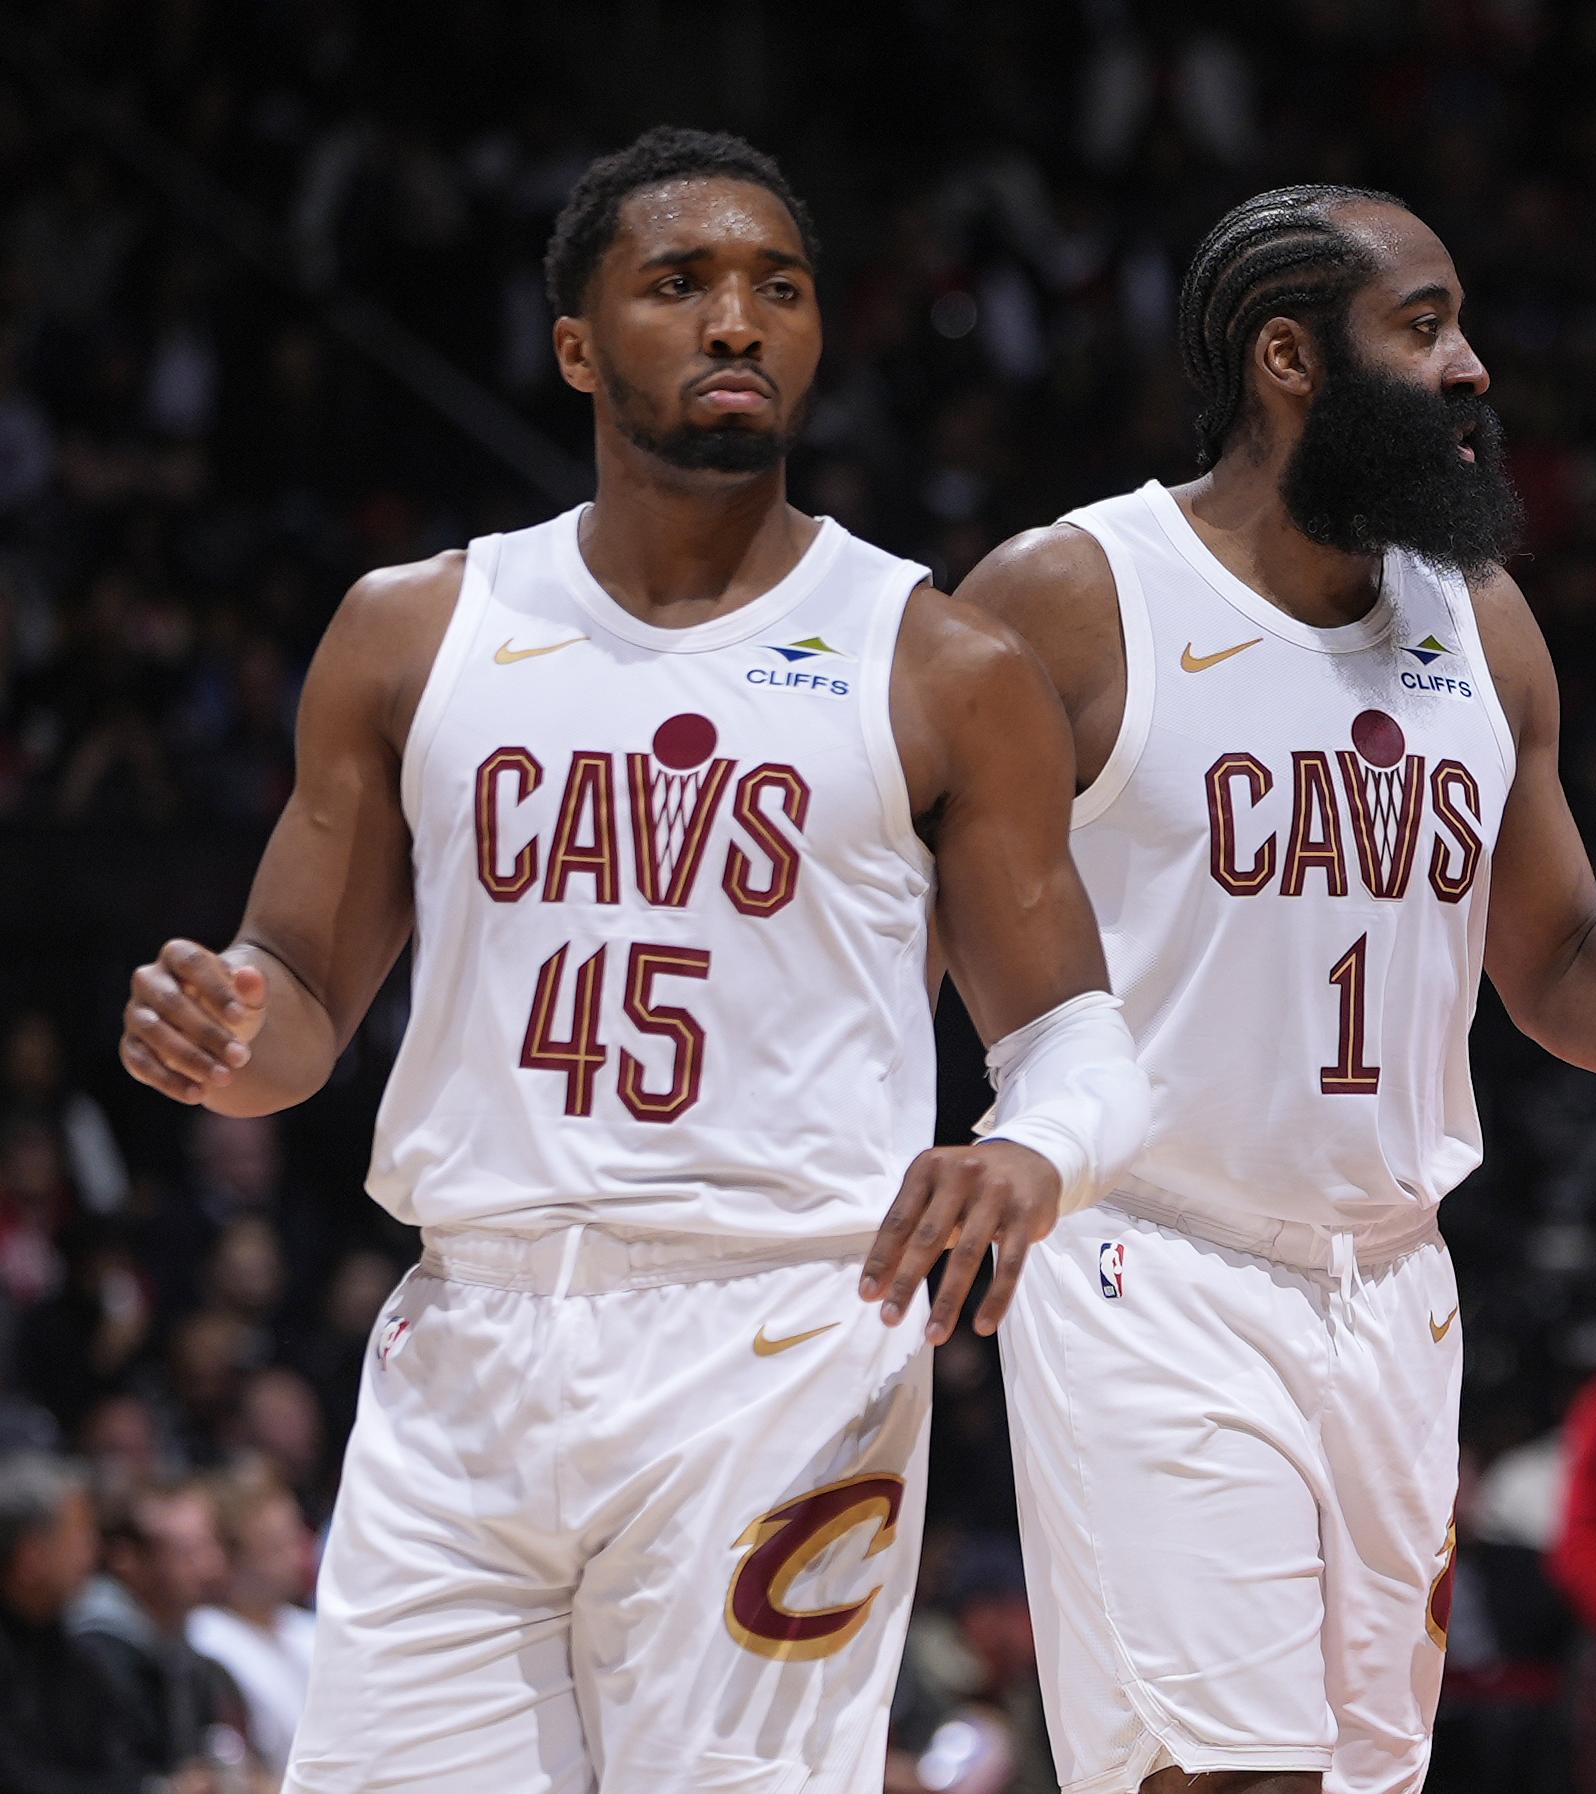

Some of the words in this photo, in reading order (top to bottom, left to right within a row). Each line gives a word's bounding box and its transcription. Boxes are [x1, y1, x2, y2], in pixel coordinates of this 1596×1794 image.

[745, 668, 850, 696] CLIFFS
[1400, 671, 1473, 698] CLIFFS
[474, 746, 812, 918] CAVS
[1203, 750, 1483, 905] CAVS
[518, 940, 712, 1125] 45
[1319, 931, 1381, 1096] 1
[723, 1470, 906, 1662] C
